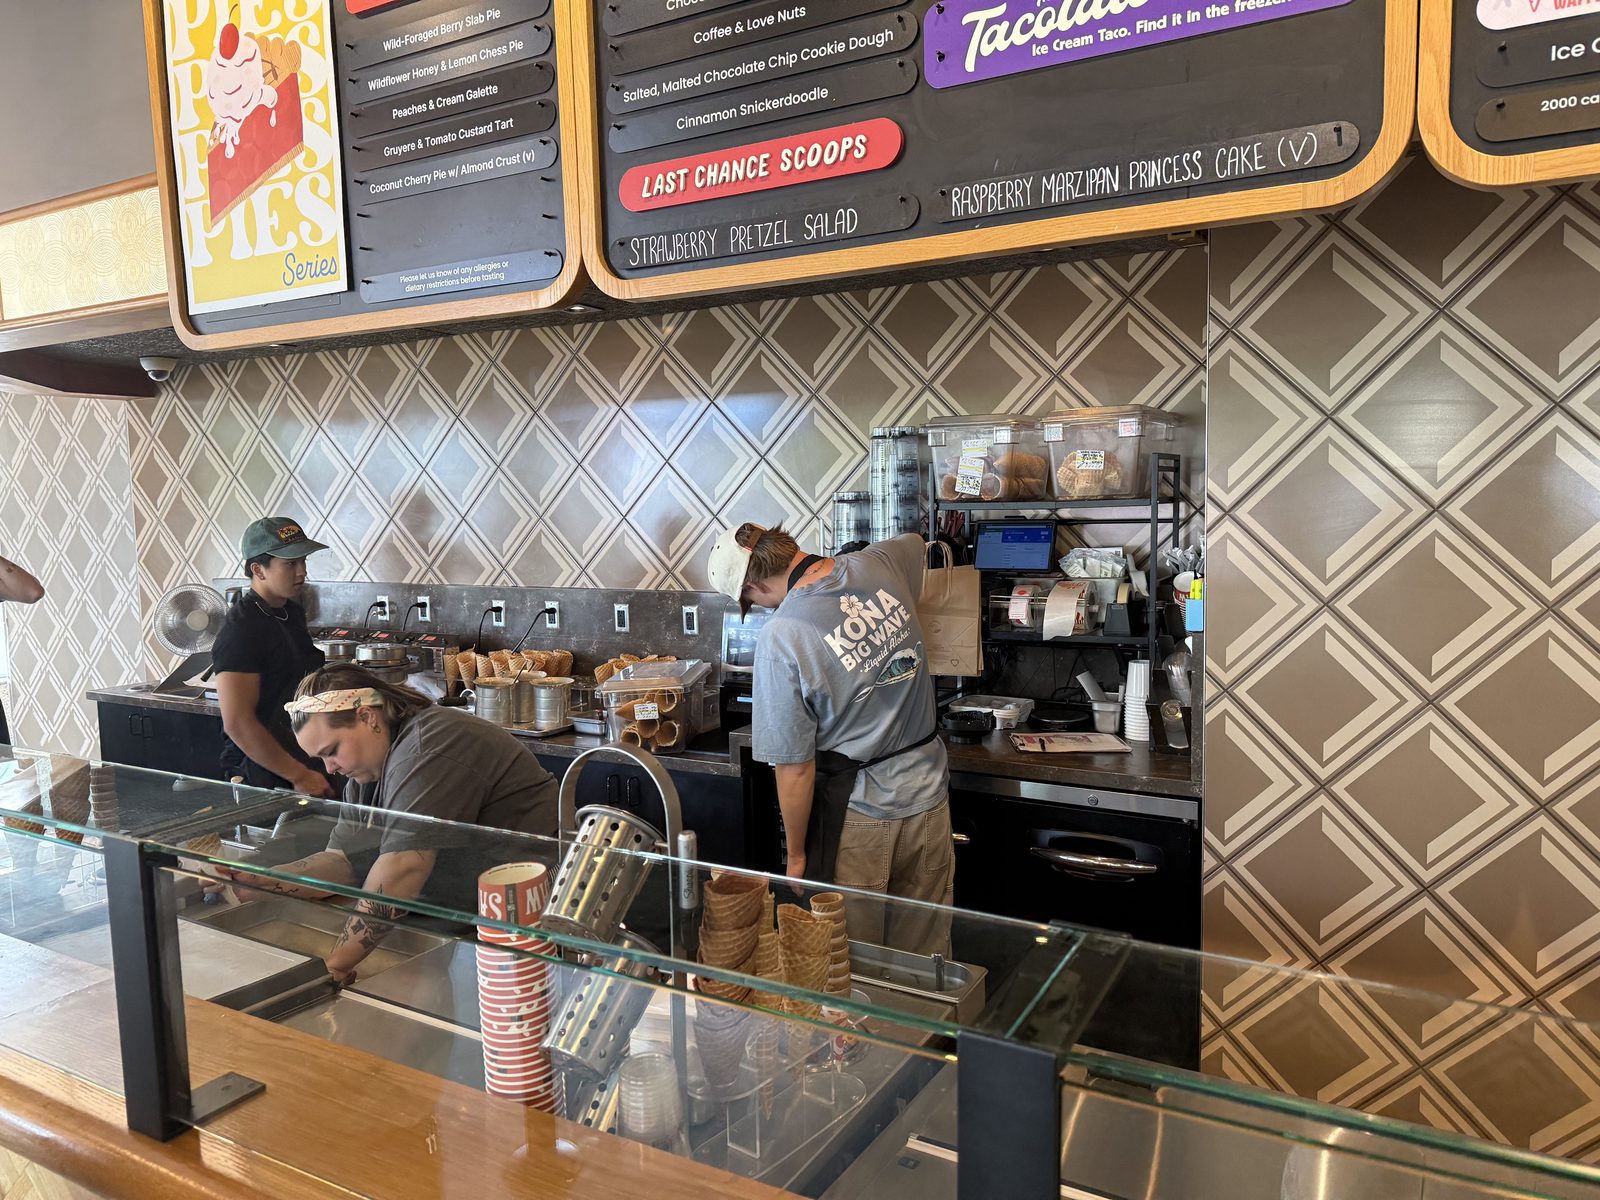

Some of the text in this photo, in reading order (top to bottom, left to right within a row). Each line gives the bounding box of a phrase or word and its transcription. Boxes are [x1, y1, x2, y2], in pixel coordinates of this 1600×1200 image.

[383, 9, 501, 51] Wild-Foraged Berry Slab Pie
[693, 6, 806, 44] Coffee & Love Nuts
[1031, 44, 1048, 57] Ice
[1052, 33, 1093, 51] Cream
[1098, 26, 1131, 43] Taco.
[1136, 16, 1167, 34] Find
[1171, 13, 1182, 27] it
[1187, 9, 1200, 23] in
[1205, 4, 1229, 19] the
[368, 40, 524, 91] Wildflower Honey & Lemon Chess Pie
[623, 28, 894, 103] Salted, Malted Chocolate Chip Cookie Dough
[1551, 43, 1585, 61] Ice
[392, 84, 499, 119] Peaches & Cream Galette
[676, 87, 829, 130] Cinnamon Snickerdoodle
[1541, 96, 1578, 111] 2000
[384, 117, 514, 158] Gruyere & Tomato Custard Tart
[369, 149, 536, 194] Coconut Cherry Pie w/ Almond Crust (v)
[641, 134, 868, 199] LAST CHANCE SCOOPS
[952, 131, 1318, 217] RASPBERRY MARZIPAN PRINCESS CAKE (V)
[730, 219, 793, 253] PRETZEL
[804, 207, 858, 240] SALAD
[282, 252, 338, 287] Series
[400, 274, 419, 284] Please
[419, 272, 428, 280] let
[436, 269, 452, 278] know
[453, 267, 460, 275] of
[460, 267, 473, 275] any
[473, 261, 501, 273] allergies
[501, 260, 509, 268] or
[405, 271, 504, 293] dietary restrictions before tasting
[823, 588, 901, 658] KONA
[840, 605, 912, 672] BIG WAVE
[863, 629, 909, 673] Liquid Aloha
